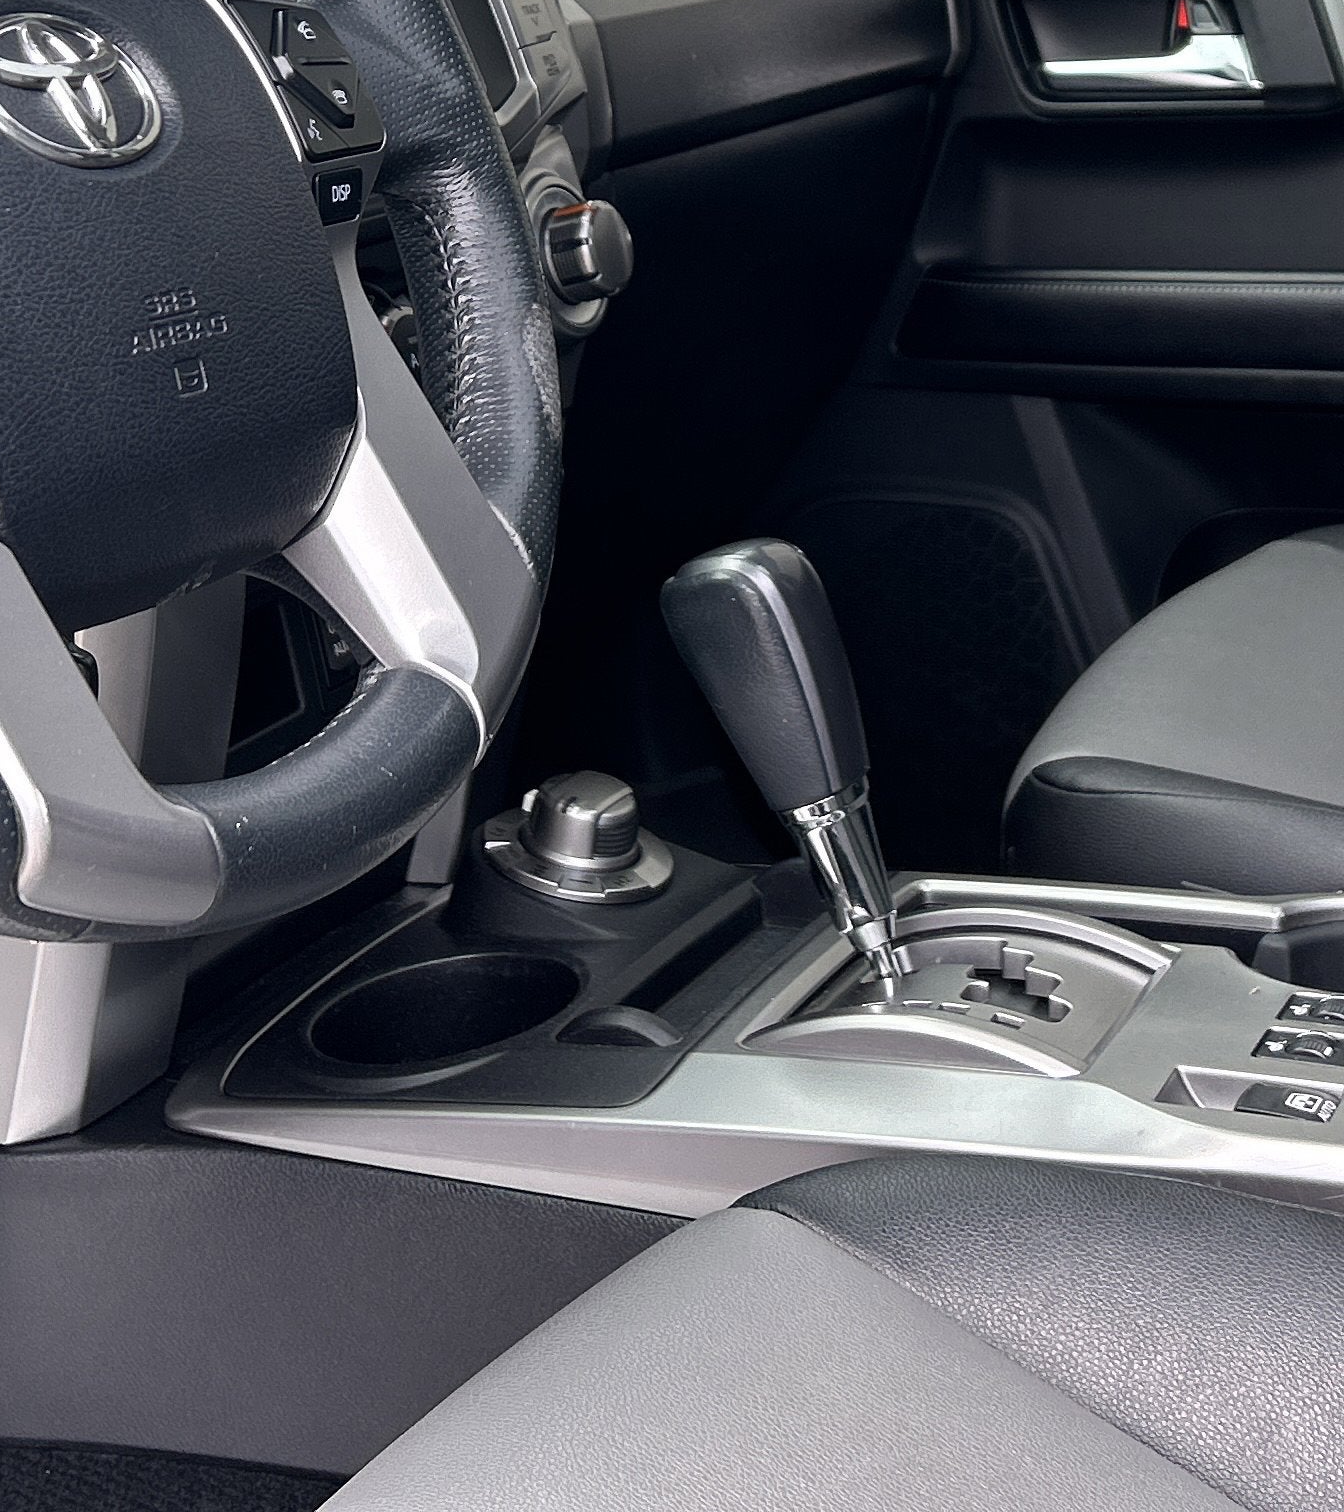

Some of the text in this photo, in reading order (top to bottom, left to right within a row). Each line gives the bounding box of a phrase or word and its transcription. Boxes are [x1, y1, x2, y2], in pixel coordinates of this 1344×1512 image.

[331, 183, 351, 203] DISP
[144, 287, 197, 316] SRS
[130, 311, 229, 355] AIRBAG
[1317, 1100, 1337, 1122] AUTO
